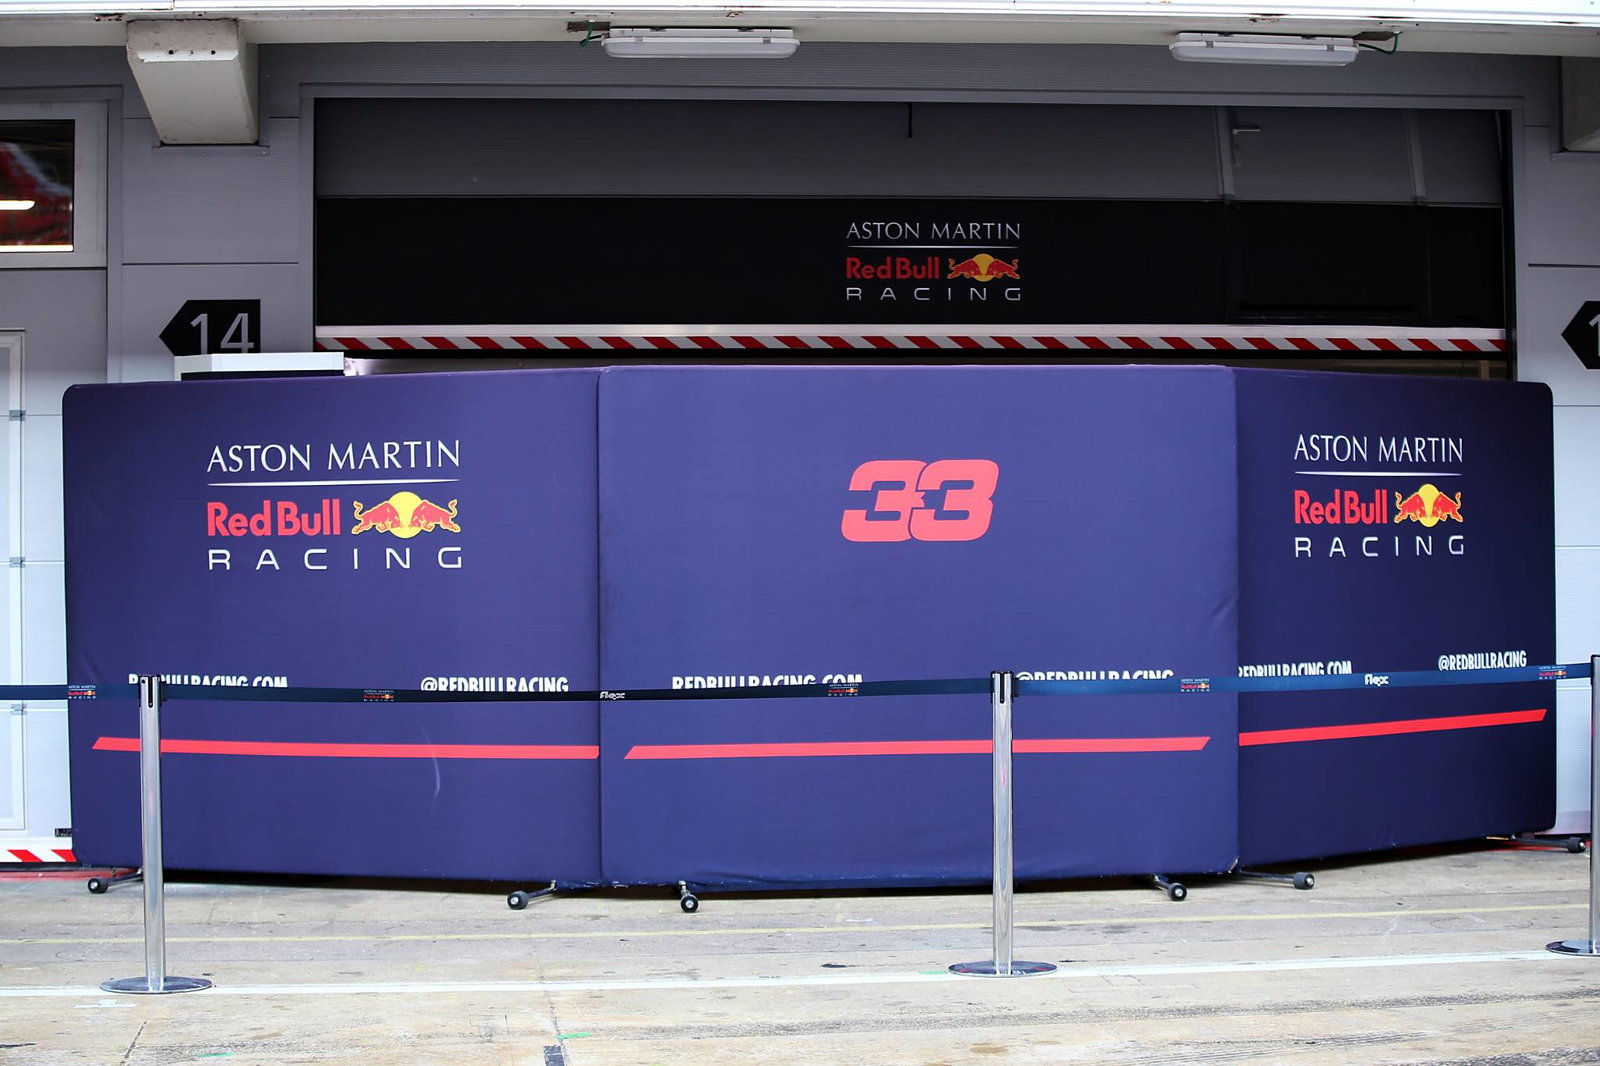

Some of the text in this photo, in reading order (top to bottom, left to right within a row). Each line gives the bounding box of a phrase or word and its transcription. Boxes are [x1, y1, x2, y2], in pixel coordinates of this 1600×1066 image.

[846, 221, 1021, 240] ASTON MARTIN
[846, 257, 940, 280] Red Bull
[846, 287, 1021, 301] RACING
[190, 312, 255, 355] 14
[207, 439, 460, 473] ASTON MARTIN
[1294, 433, 1463, 463] ASTON MARTIN
[841, 459, 999, 542] 33
[1294, 488, 1388, 525] Red Bull
[207, 498, 341, 537] Red Bull
[208, 546, 463, 571] RACING
[1294, 535, 1464, 558] RACING
[1438, 650, 1528, 671] @REDBULLRACING
